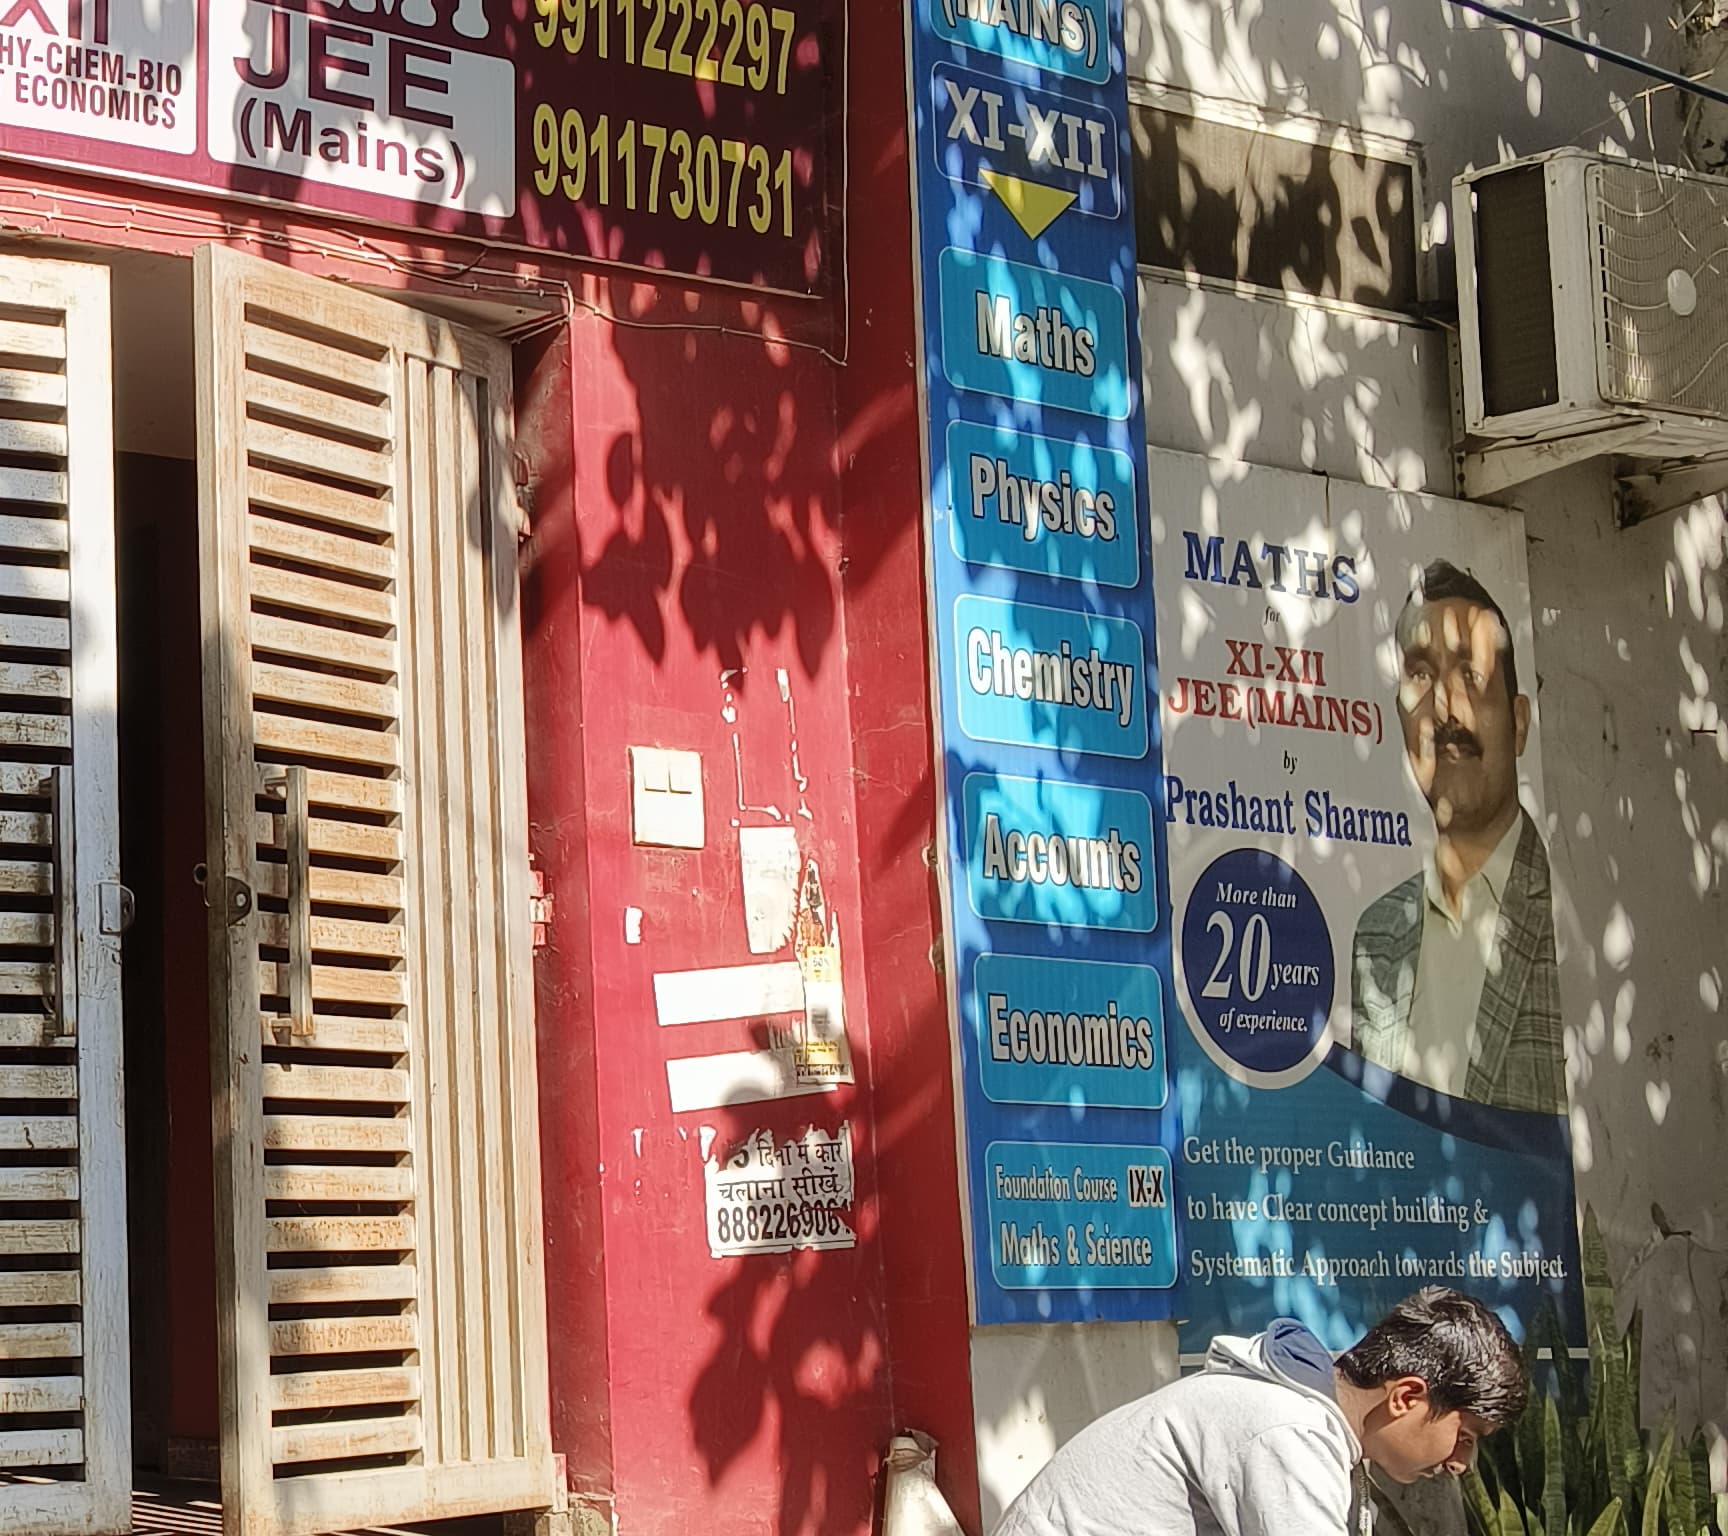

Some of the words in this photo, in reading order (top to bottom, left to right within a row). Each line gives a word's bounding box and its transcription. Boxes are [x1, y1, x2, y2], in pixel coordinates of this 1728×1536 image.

[15, 71, 176, 130] ECONOMICS
[233, 9, 453, 129] JEE
[240, 97, 466, 199] (Mains)
[944, 79, 1108, 179] XI-XII
[533, 103, 793, 237] 9911730731
[975, 290, 1096, 378] Maths
[970, 453, 1116, 542] Physics
[1182, 531, 1360, 603] MATHS
[1264, 606, 1280, 625] for
[967, 626, 1134, 728] Chemistry
[1225, 639, 1326, 686] XI-XII
[1168, 677, 1383, 744] JEE(MAINS)
[1282, 750, 1298, 775] by
[1163, 775, 1297, 836] Prashant
[1304, 789, 1412, 847] Sharma
[982, 812, 1142, 893] Accounts
[1215, 881, 1258, 904] More
[1261, 886, 1297, 908] than
[1201, 910, 1271, 1002] 20
[1270, 963, 1320, 990] years
[988, 993, 1154, 1070] Economics
[1219, 1007, 1236, 1033] of
[1236, 1009, 1308, 1035] experience.
[717, 1178, 785, 1202] चलाना
[792, 1165, 843, 1199] सीखें
[815, 1141, 844, 1163] कार
[1183, 1136, 1220, 1164] Get
[1224, 1137, 1255, 1164] the
[1260, 1146, 1323, 1174] proper
[1327, 1141, 1415, 1170] Guidance
[995, 1164, 1071, 1201] Foundation
[1073, 1166, 1118, 1202] Course
[1128, 1166, 1166, 1207] IX-X
[1187, 1195, 1207, 1220] to
[1211, 1192, 1258, 1220] have
[1262, 1193, 1313, 1221] Clear
[1317, 1199, 1388, 1231] concept
[1392, 1195, 1470, 1233] building
[1000, 1221, 1060, 1266] Maths
[1085, 1221, 1153, 1266] Science
[1191, 1249, 1296, 1285] Systematic
[1300, 1249, 1391, 1286] Approach
[1395, 1251, 1466, 1278] towards
[1468, 1251, 1497, 1278] the
[1500, 1251, 1568, 1286] Subject.
